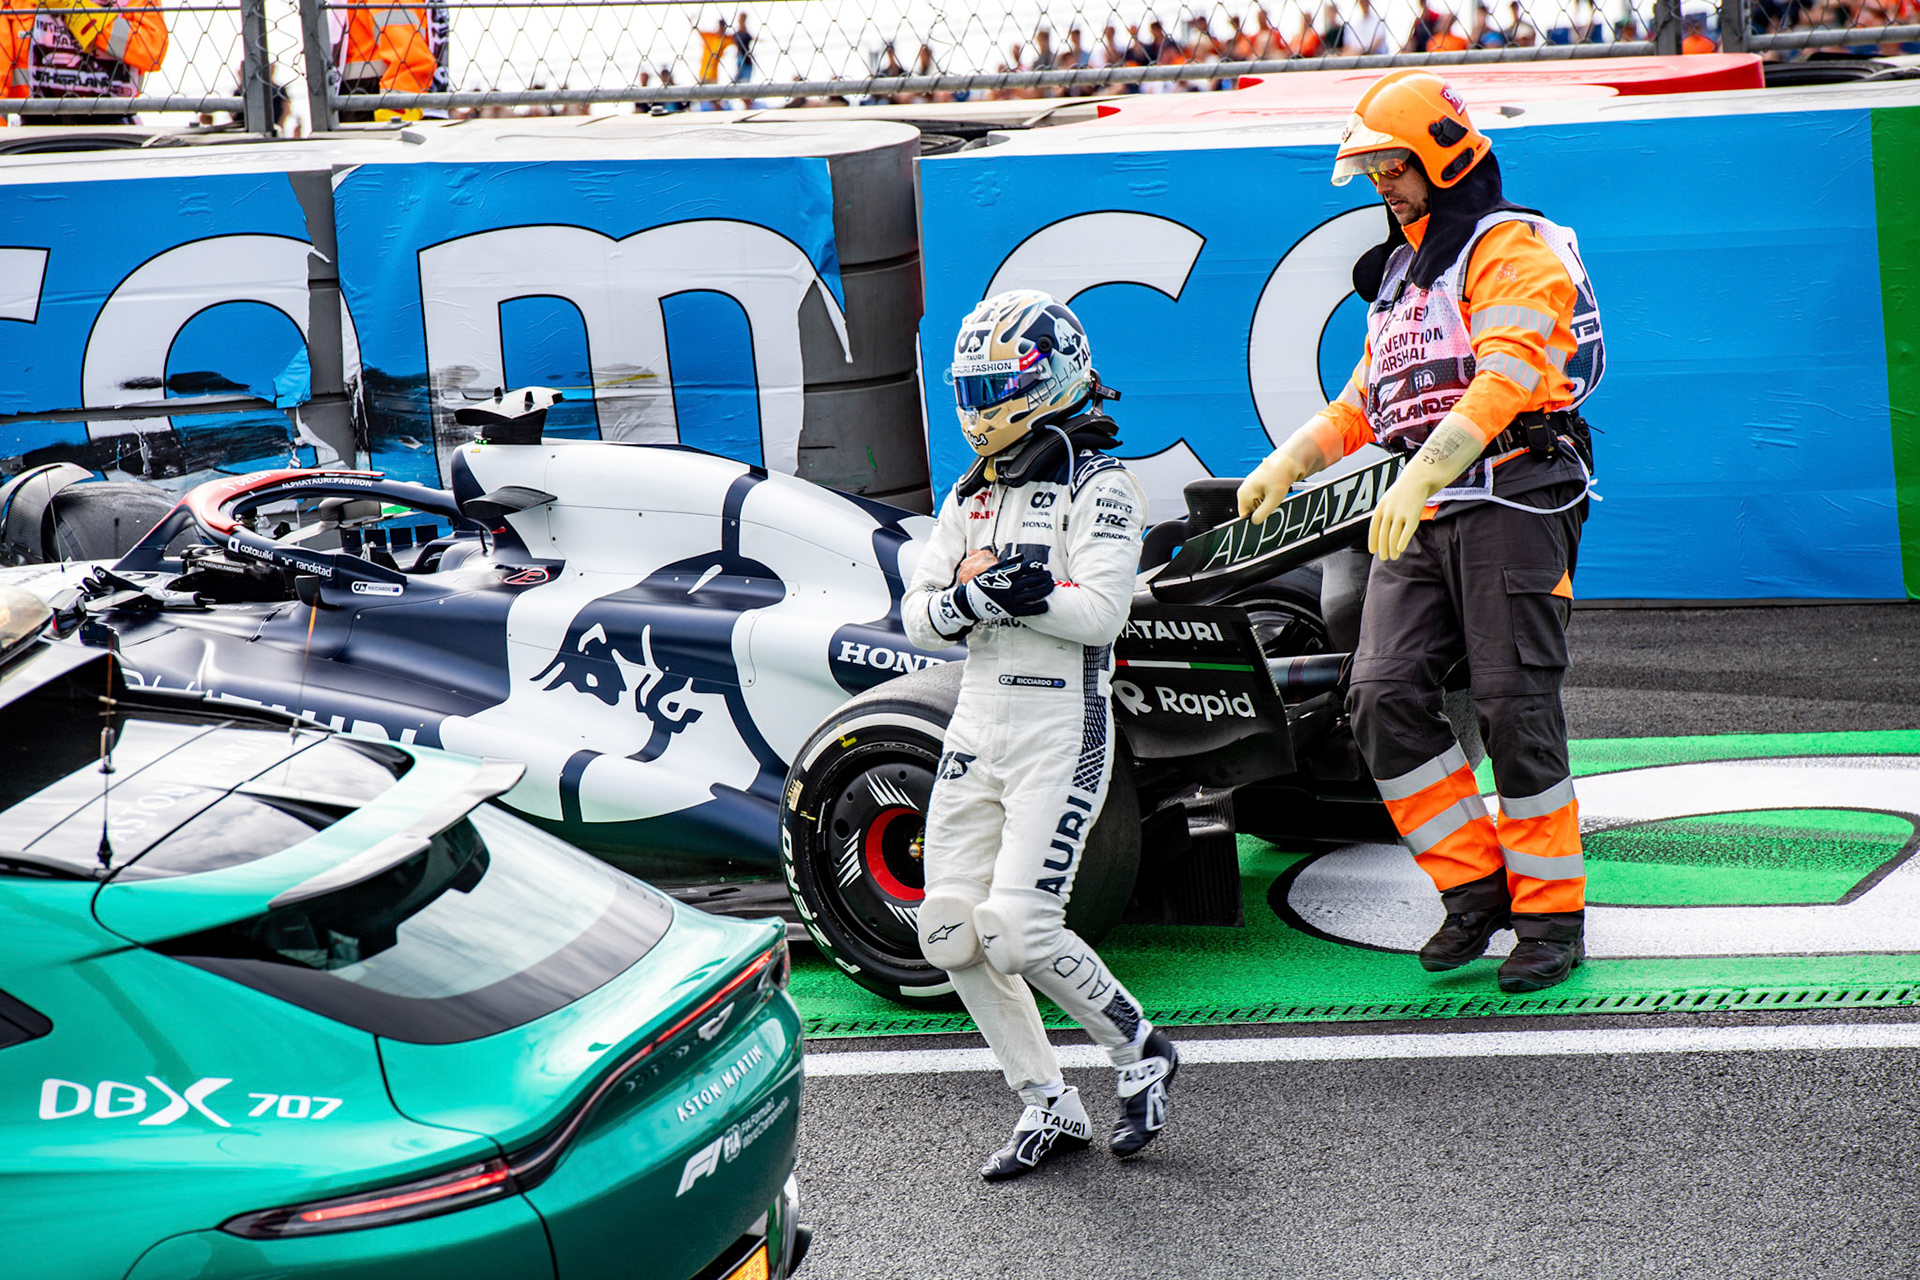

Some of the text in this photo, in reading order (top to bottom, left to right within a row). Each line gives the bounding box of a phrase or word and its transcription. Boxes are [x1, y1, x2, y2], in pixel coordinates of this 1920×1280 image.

[281, 477, 373, 490] ALPHATAURI.FASHION
[1021, 521, 1053, 530] HONDA
[240, 544, 274, 562] catawiki
[295, 560, 333, 578] randstad
[1120, 619, 1224, 642] ATAURI
[1016, 677, 1053, 686] RICCIARDO
[1155, 686, 1257, 722] Rapid
[675, 1044, 764, 1124] ASTON MARTIN
[38, 1075, 344, 1128] DBX 707
[675, 1135, 724, 1198] F1
